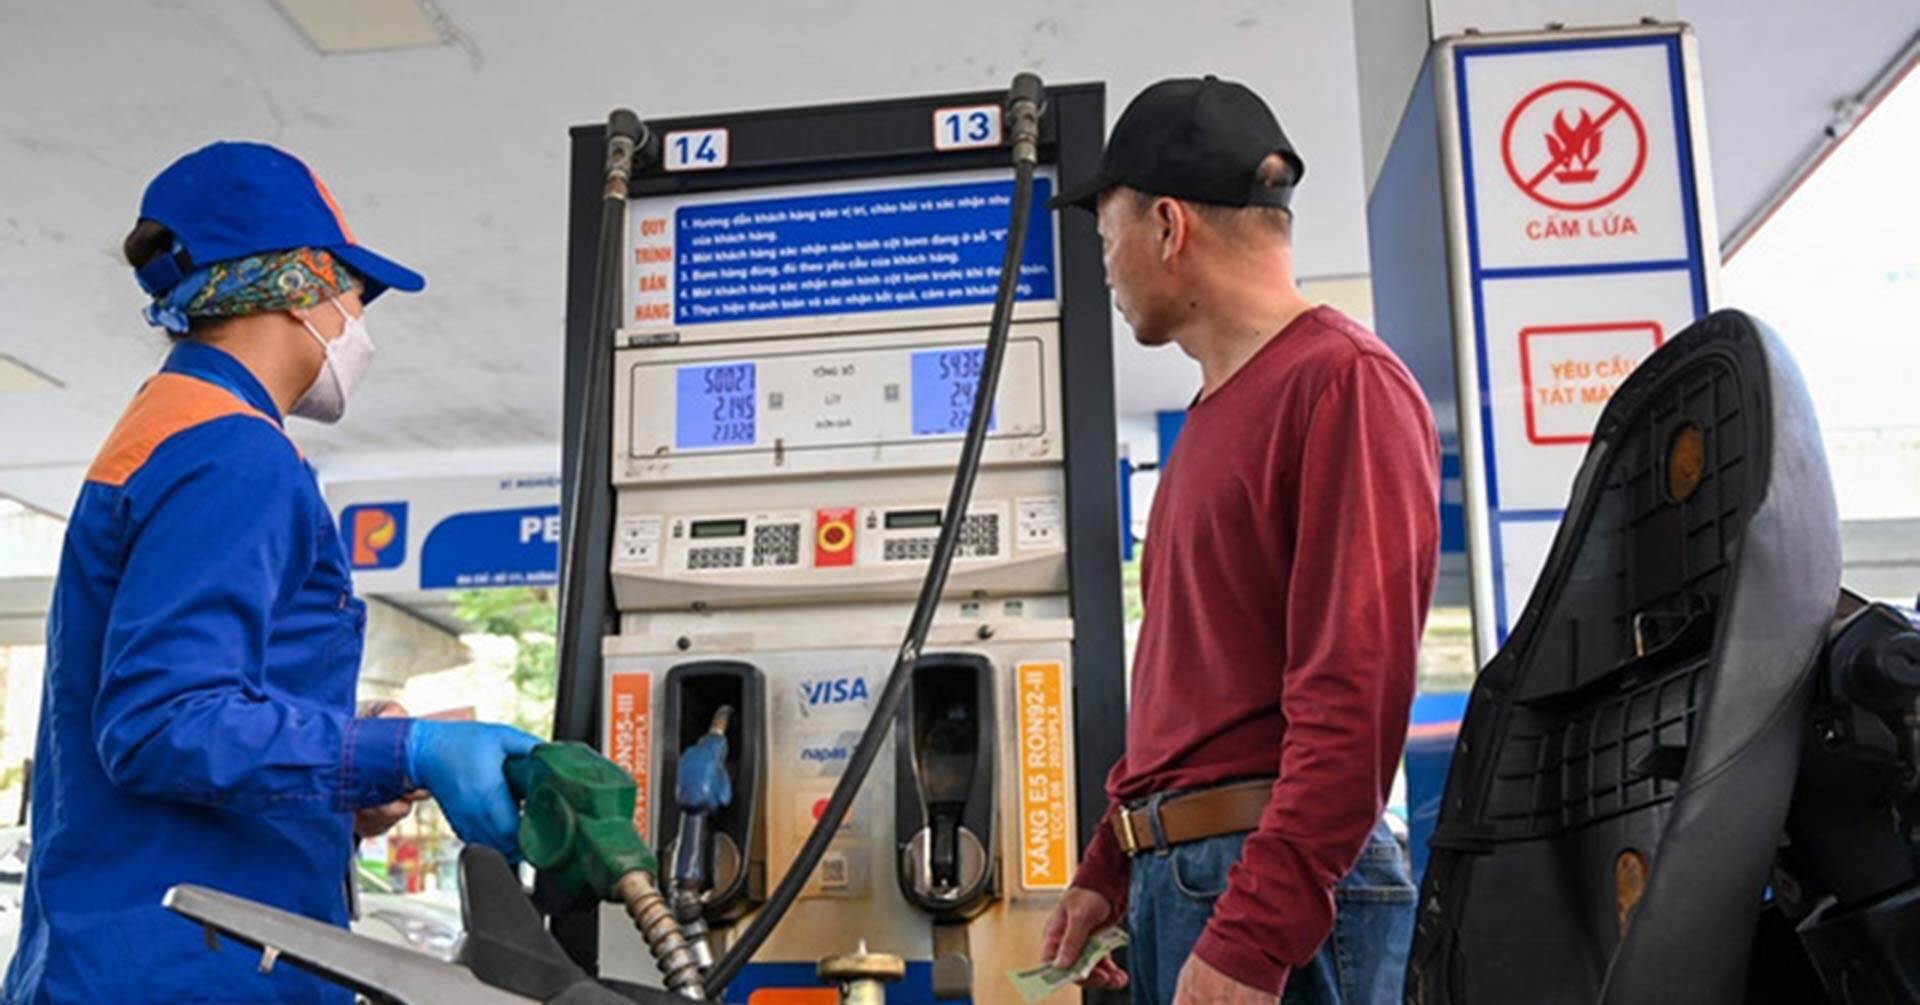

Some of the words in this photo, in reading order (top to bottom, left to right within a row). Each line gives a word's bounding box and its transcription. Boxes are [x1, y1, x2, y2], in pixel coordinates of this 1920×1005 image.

[945, 112, 991, 143] 13
[675, 134, 718, 165] 14
[755, 212, 786, 223] khách
[1526, 214, 1580, 241] CẤM
[1588, 212, 1637, 236] LỬA
[641, 219, 667, 236] QUY
[714, 233, 745, 243] khách
[715, 249, 746, 261] khách
[893, 253, 926, 265] khách
[715, 284, 746, 296] khách
[1550, 358, 1590, 379] YÊU
[1581, 382, 1614, 403] MÁ
[803, 677, 869, 704] VISA
[615, 693, 635, 775] ON95-III
[801, 746, 847, 761] napas
